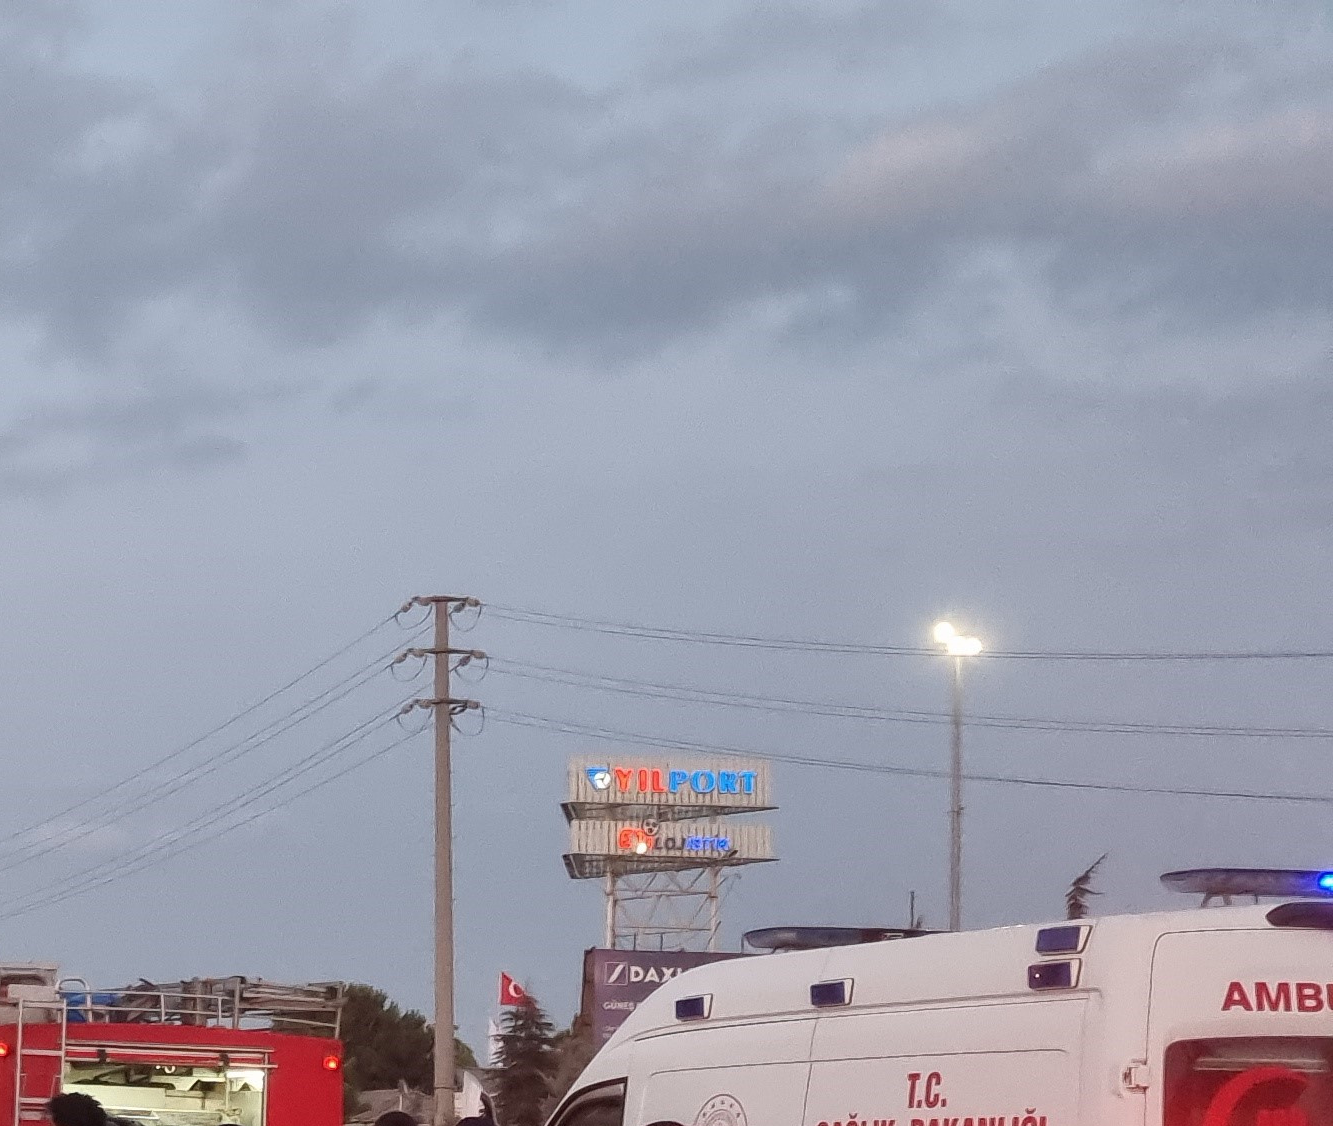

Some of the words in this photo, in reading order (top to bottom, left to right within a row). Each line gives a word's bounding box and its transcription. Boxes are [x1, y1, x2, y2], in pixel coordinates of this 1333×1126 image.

[614, 767, 758, 795] YILPORT
[1221, 981, 1333, 1014] AMB
[906, 1072, 947, 1109] T.C.
